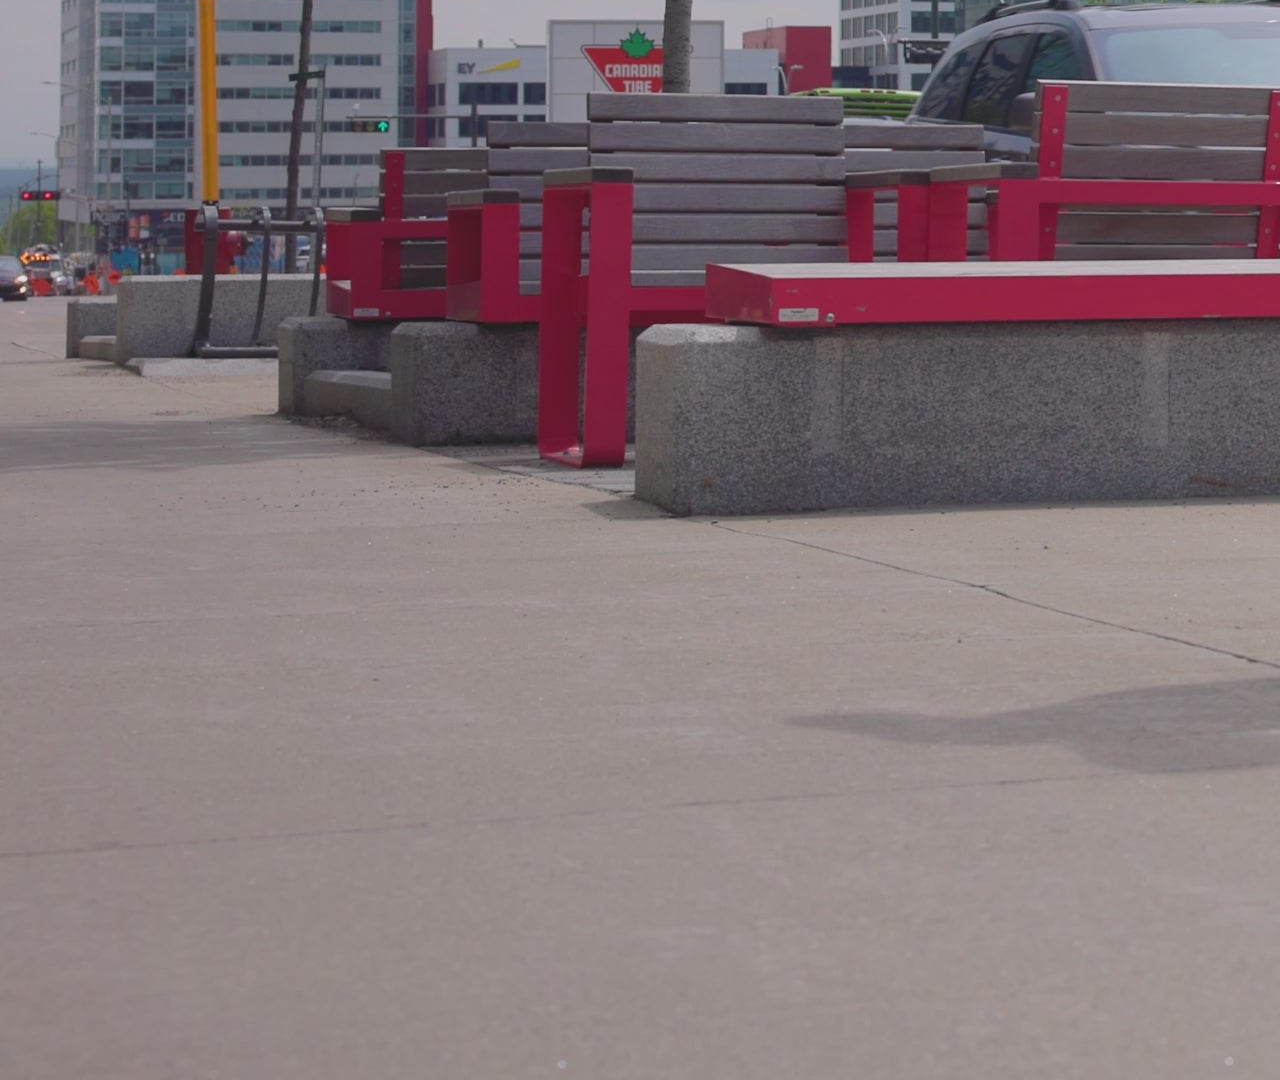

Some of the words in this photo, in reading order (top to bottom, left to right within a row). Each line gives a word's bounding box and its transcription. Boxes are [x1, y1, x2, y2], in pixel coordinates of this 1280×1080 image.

[457, 62, 476, 74] EY
[604, 63, 663, 78] CANADIA
[622, 80, 652, 93] TIRE
